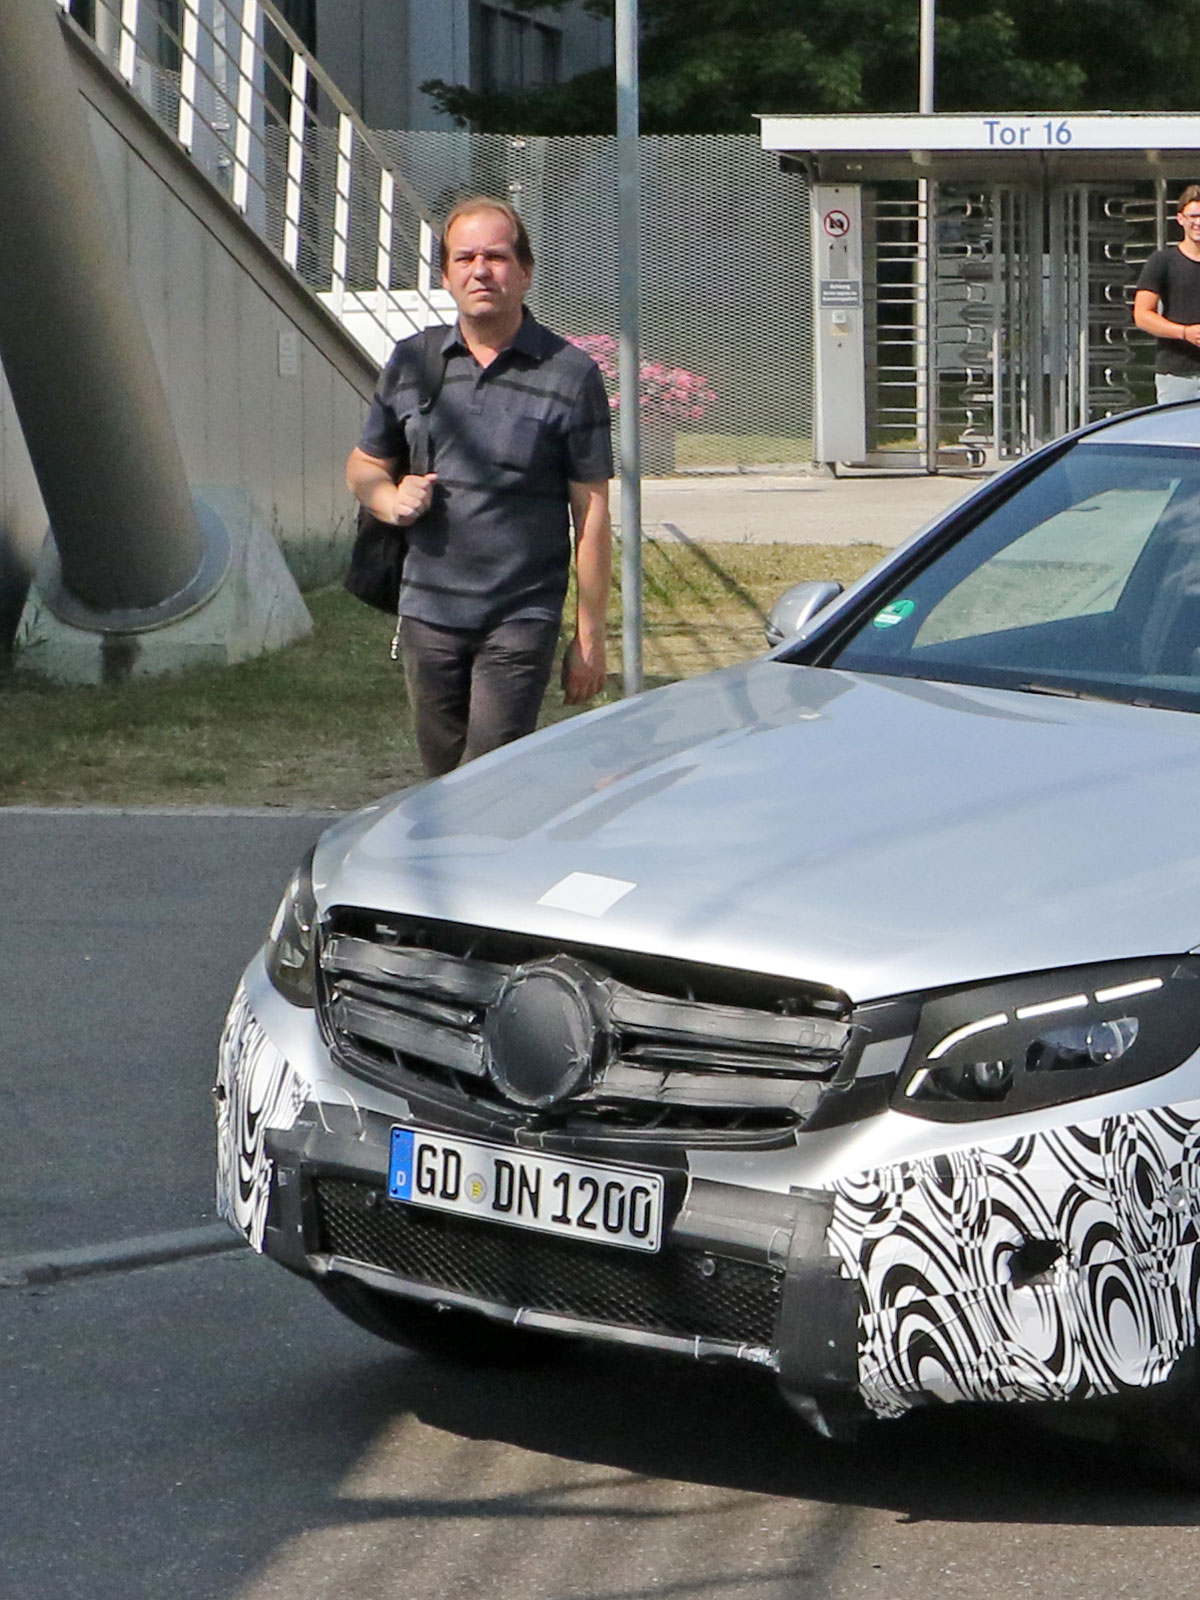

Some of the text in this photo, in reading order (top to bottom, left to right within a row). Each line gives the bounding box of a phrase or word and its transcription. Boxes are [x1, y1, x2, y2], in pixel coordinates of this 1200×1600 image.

[983, 120, 1072, 145] Tor 16
[395, 1171, 406, 1186] D
[416, 1143, 651, 1238] GD DN 1200
